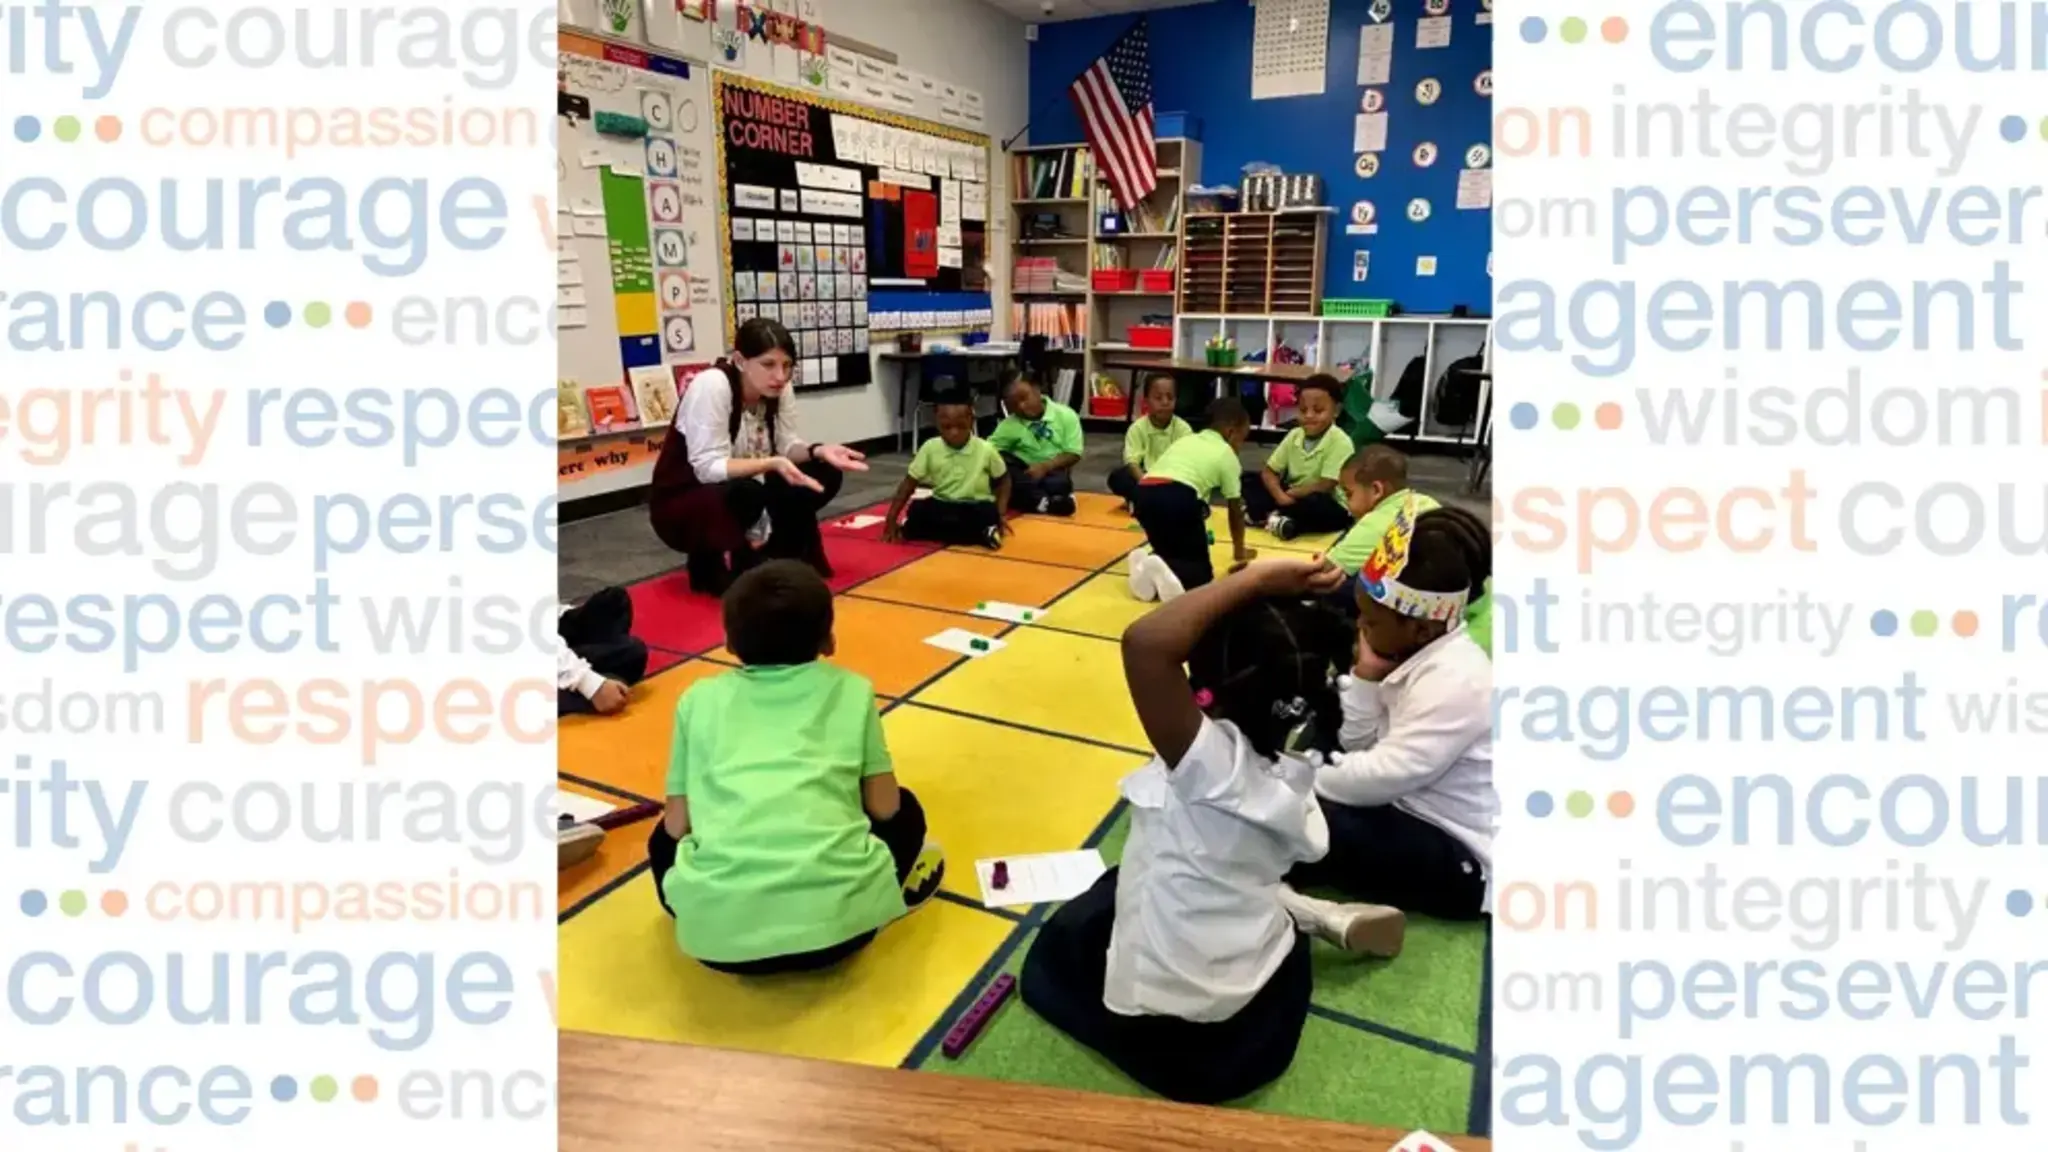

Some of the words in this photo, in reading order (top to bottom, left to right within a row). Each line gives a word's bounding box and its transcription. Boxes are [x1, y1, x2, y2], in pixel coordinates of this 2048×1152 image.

[652, 104, 663, 121] C
[724, 86, 810, 130] NUMBER
[728, 119, 814, 157] CORNER
[656, 152, 667, 167] H
[662, 197, 673, 213] A
[663, 243, 679, 259] M
[557, 462, 585, 477] ere
[594, 448, 629, 468] why
